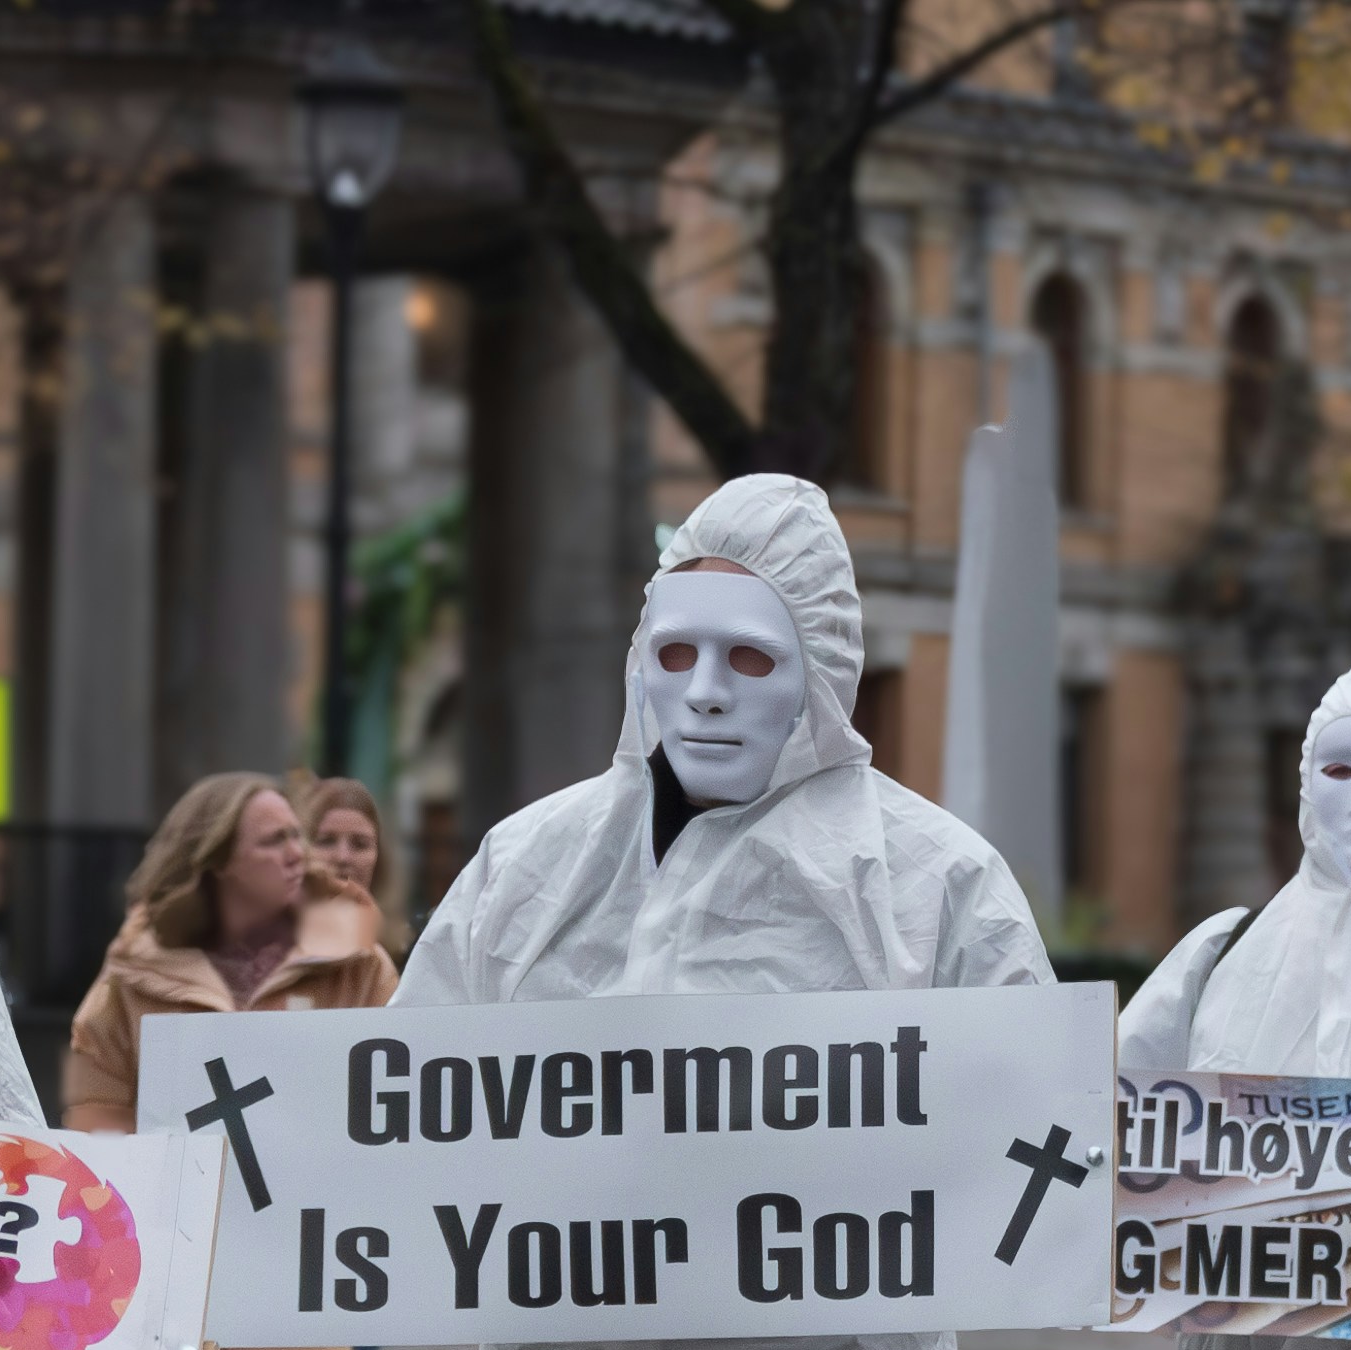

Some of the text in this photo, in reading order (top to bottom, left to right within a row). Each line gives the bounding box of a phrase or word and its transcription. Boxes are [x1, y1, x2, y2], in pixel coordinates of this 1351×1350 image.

[348, 1026, 928, 1146] Goverment
[1117, 1097, 1179, 1168] til
[298, 1189, 935, 1312] Is Your God
[1185, 1224, 1345, 1300] MER
